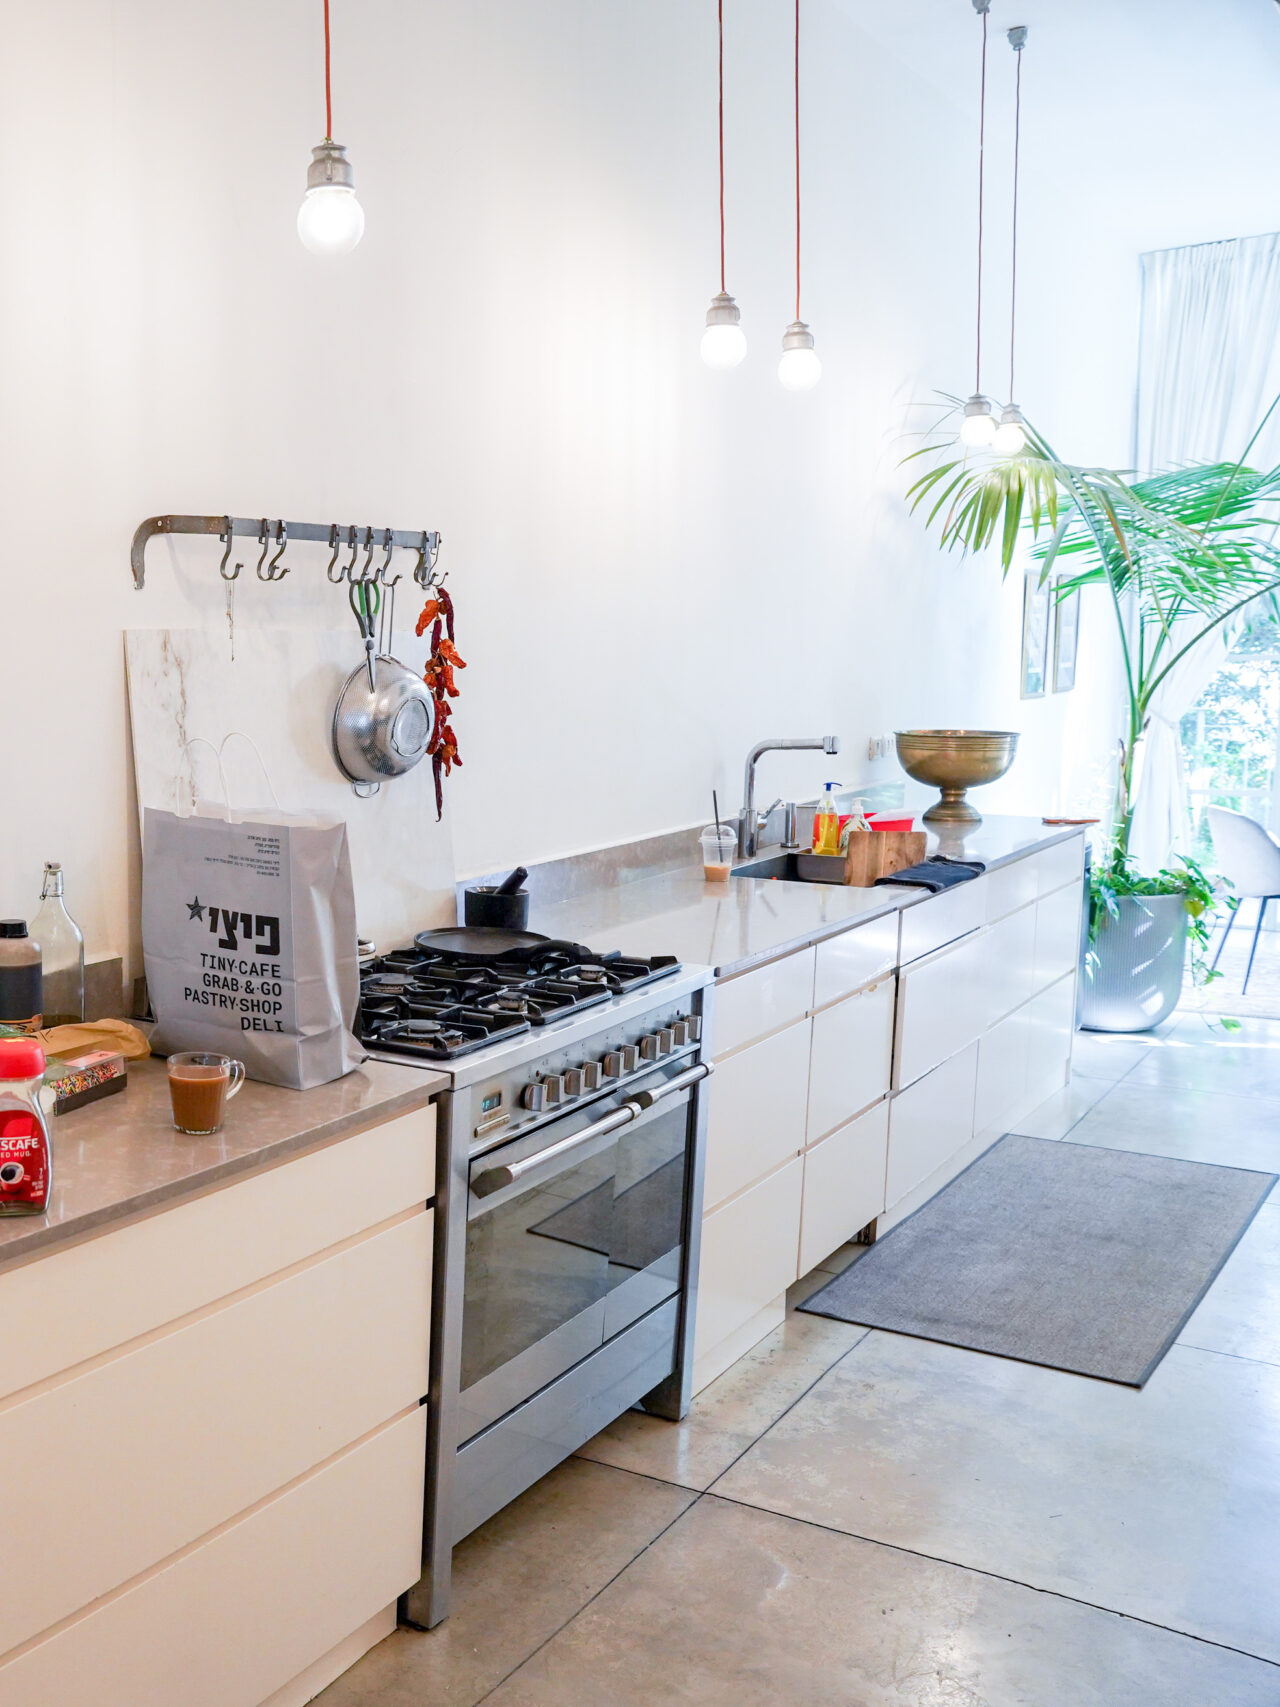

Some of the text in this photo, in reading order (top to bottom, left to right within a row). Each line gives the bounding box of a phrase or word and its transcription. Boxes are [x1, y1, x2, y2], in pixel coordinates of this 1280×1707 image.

[208, 906, 280, 956] פוצי
[200, 953, 281, 978] TINY CAFE
[202, 972, 239, 992] GRAB
[260, 982, 282, 997] GO
[184, 987, 283, 1015] PASTRY SHOP
[240, 1016, 284, 1032] DELI
